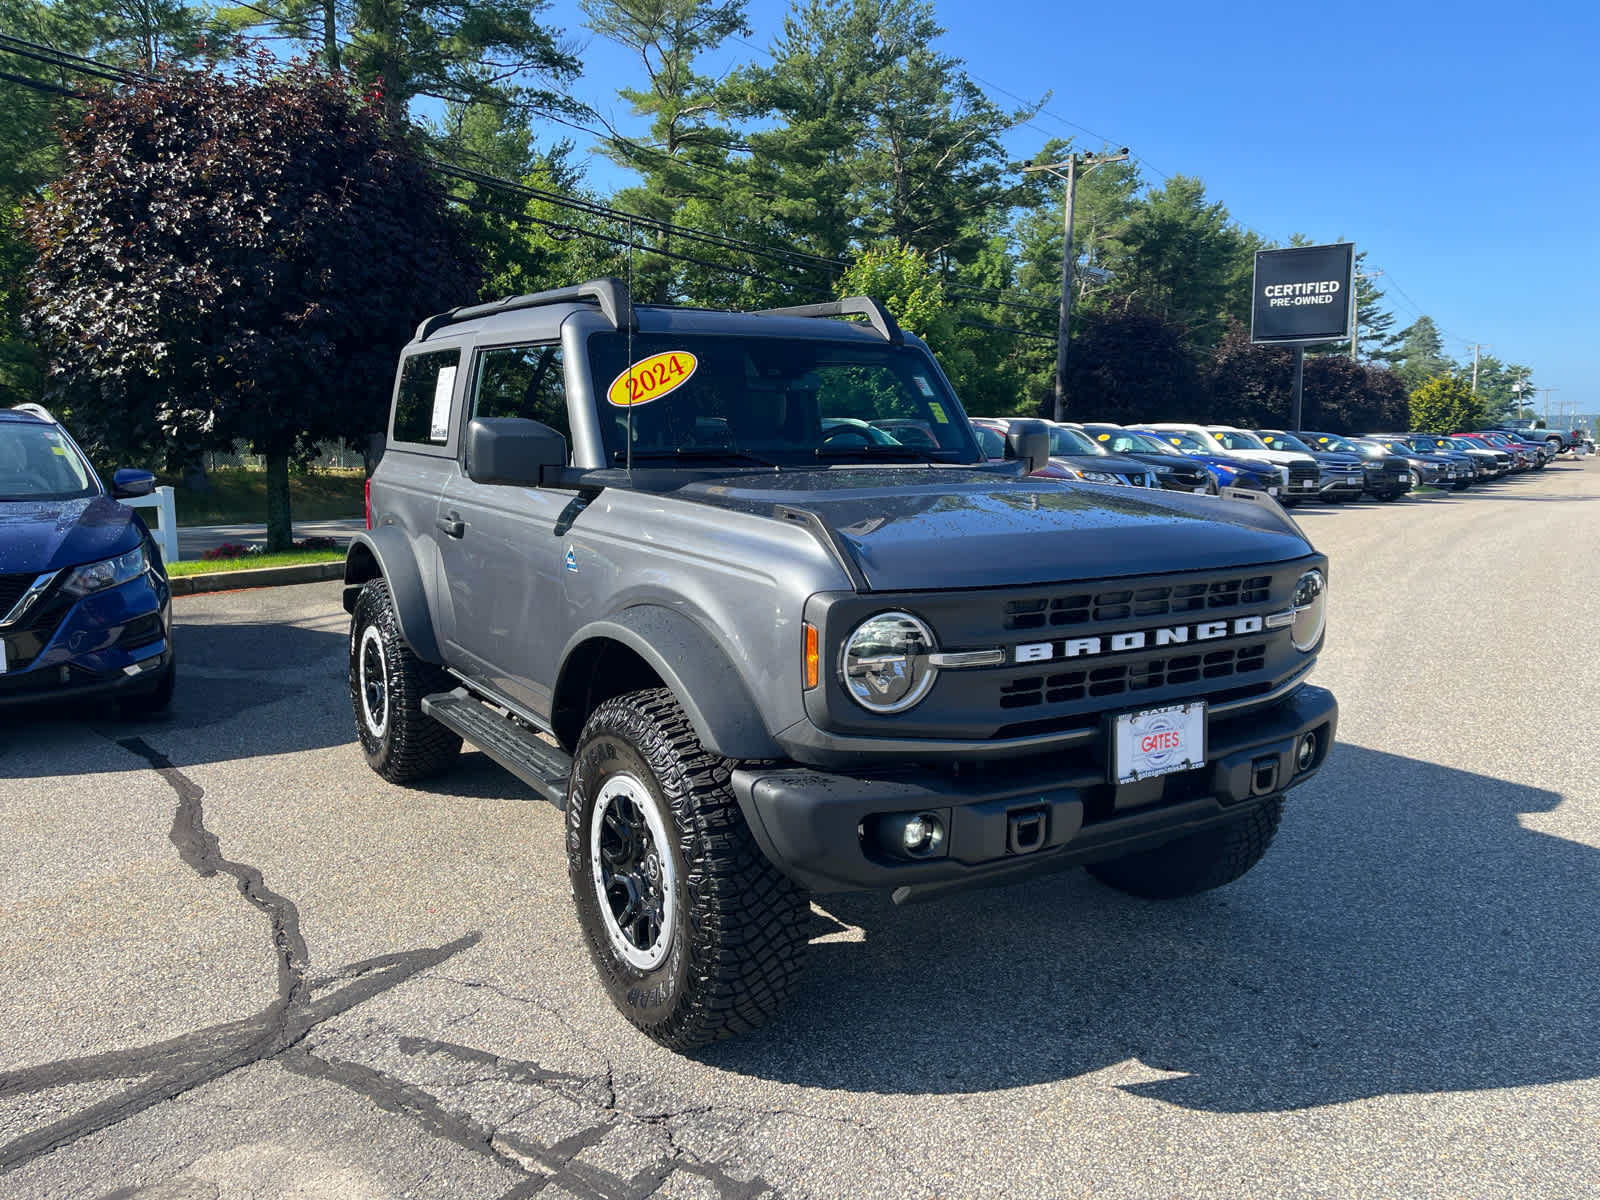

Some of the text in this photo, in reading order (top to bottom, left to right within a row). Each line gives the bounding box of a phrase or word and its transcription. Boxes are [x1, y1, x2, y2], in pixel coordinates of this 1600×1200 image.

[1264, 281, 1340, 297] CERTIFIED
[1270, 295, 1333, 307] PRE-OWNED
[625, 355, 685, 401] 2024
[1015, 616, 1263, 663] BRONCO
[1139, 704, 1185, 717] GATES
[1141, 731, 1179, 752] GATES
